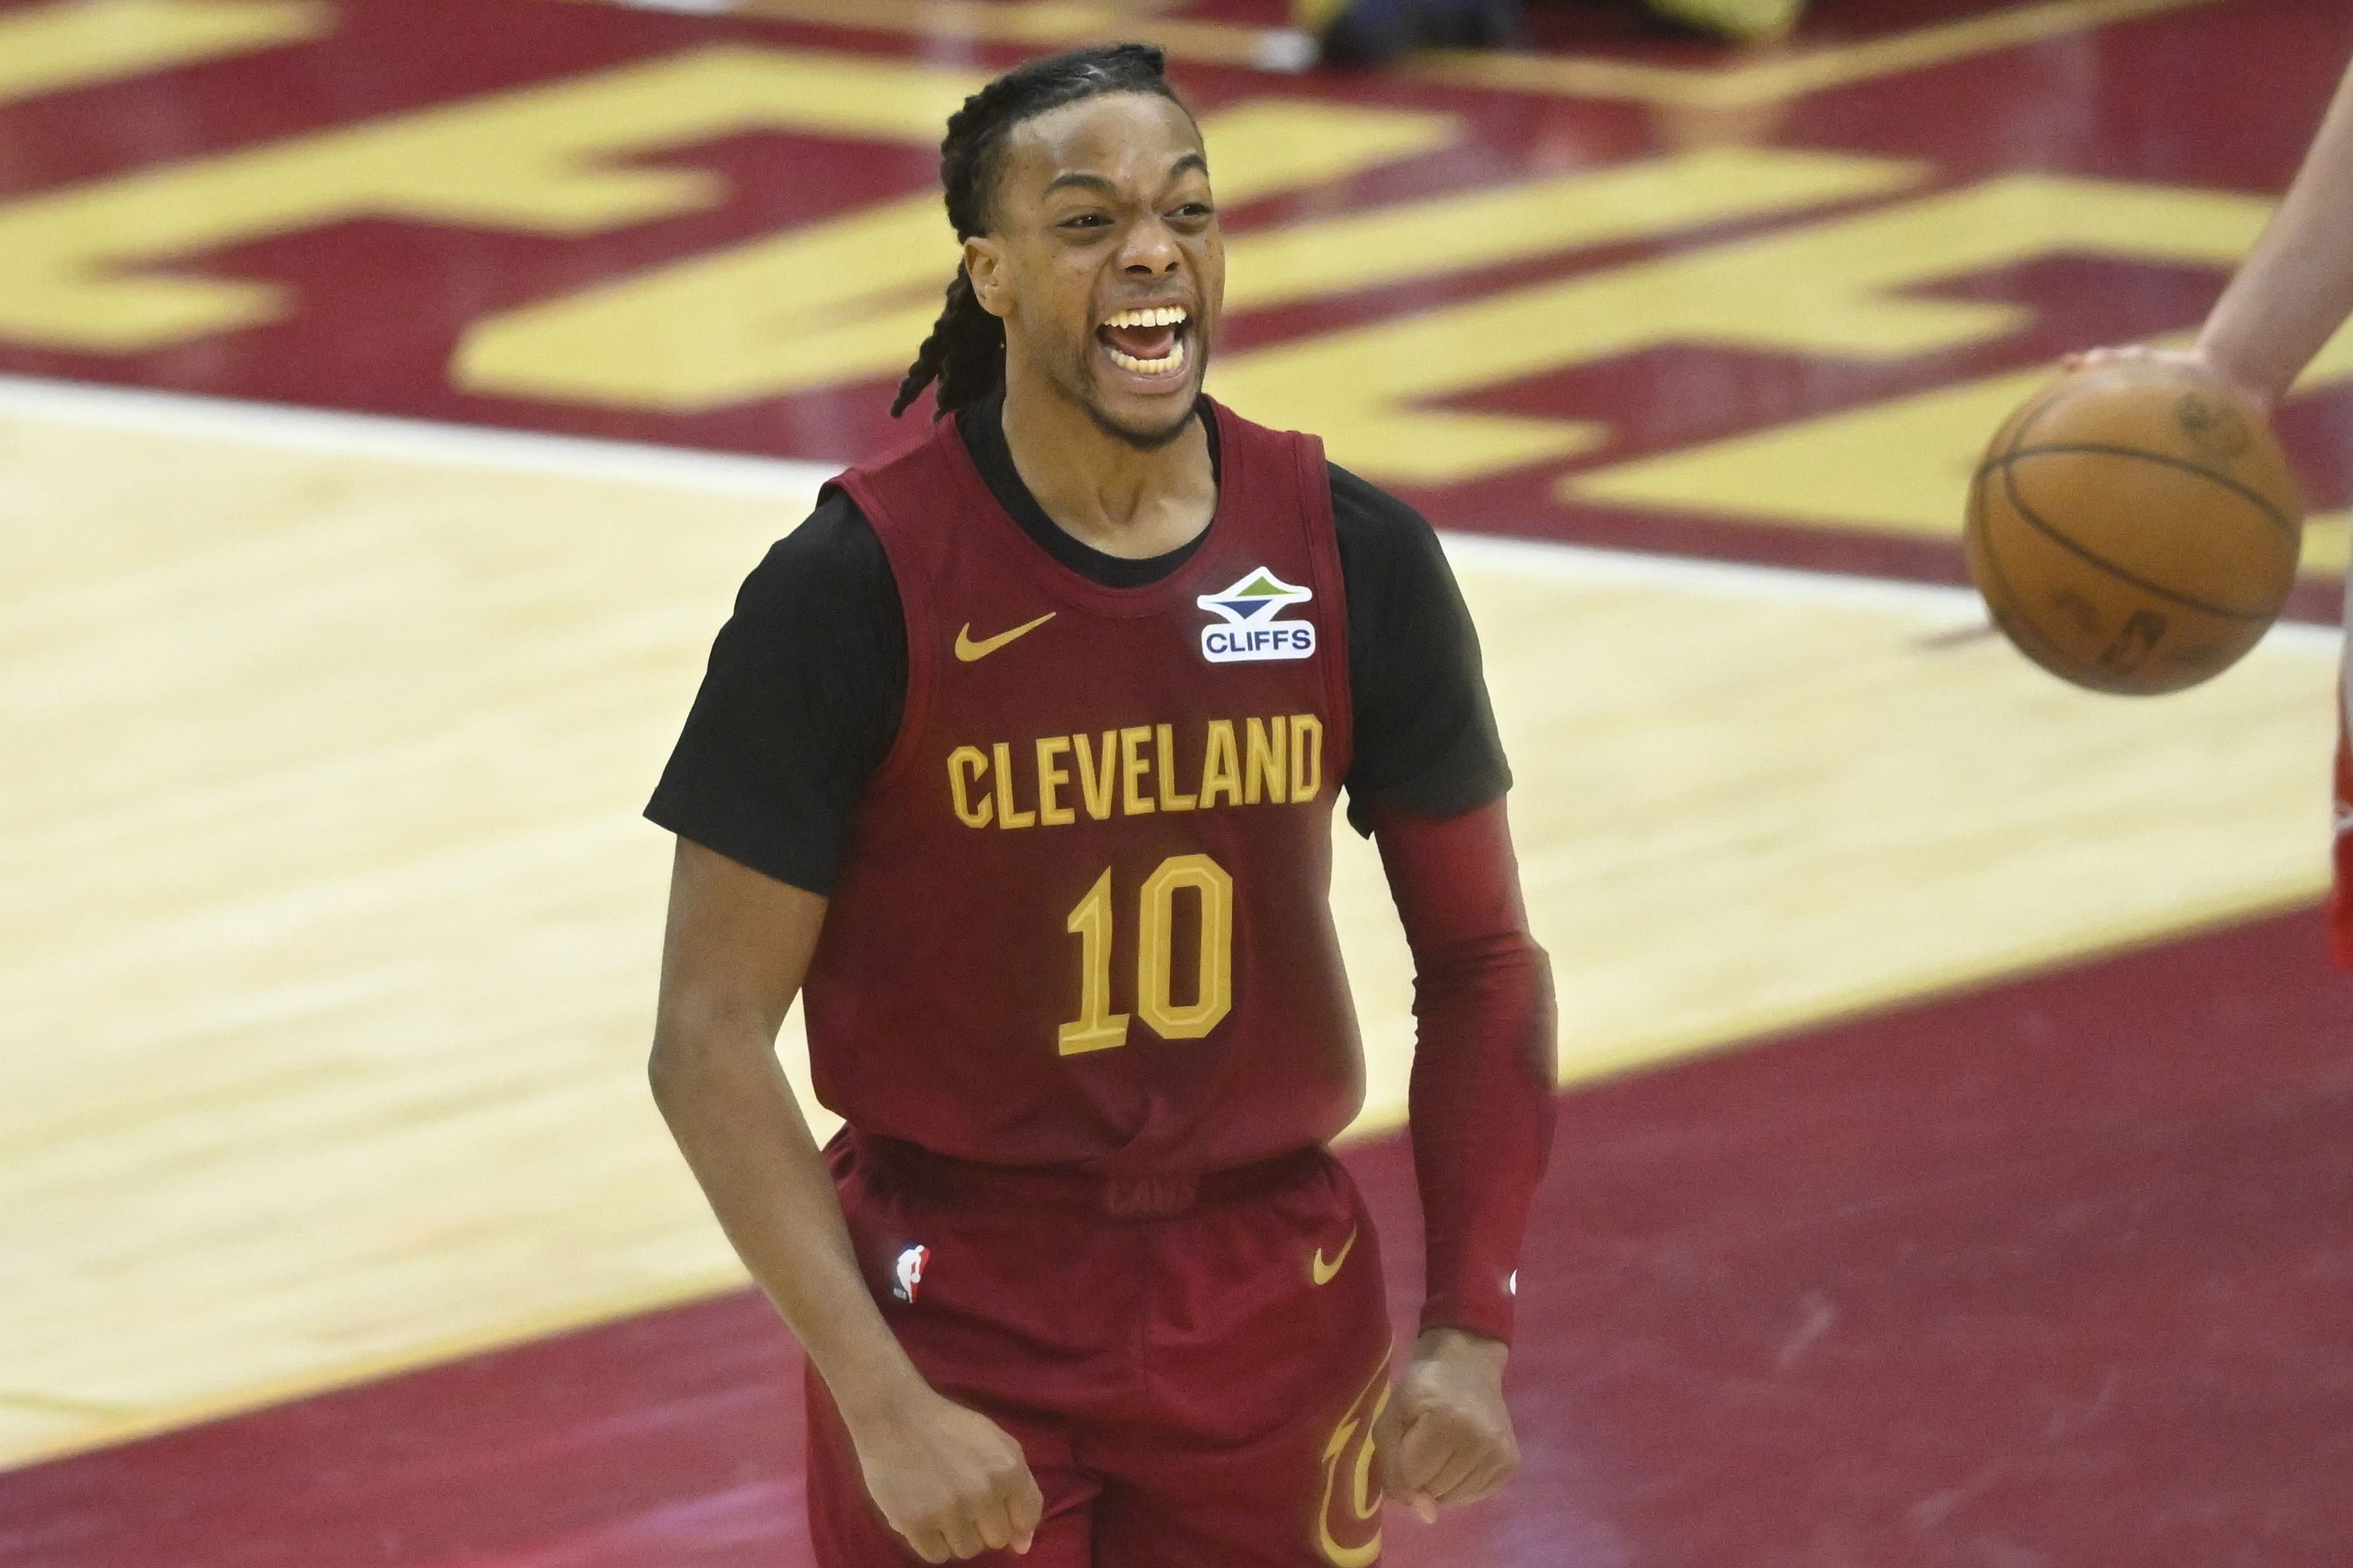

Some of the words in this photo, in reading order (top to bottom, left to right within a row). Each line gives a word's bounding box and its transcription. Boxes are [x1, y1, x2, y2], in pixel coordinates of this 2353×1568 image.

[1206, 629, 1311, 654] CLIFFS
[946, 713, 1323, 830] CLEVELAND
[1058, 853, 1234, 1056] 10
